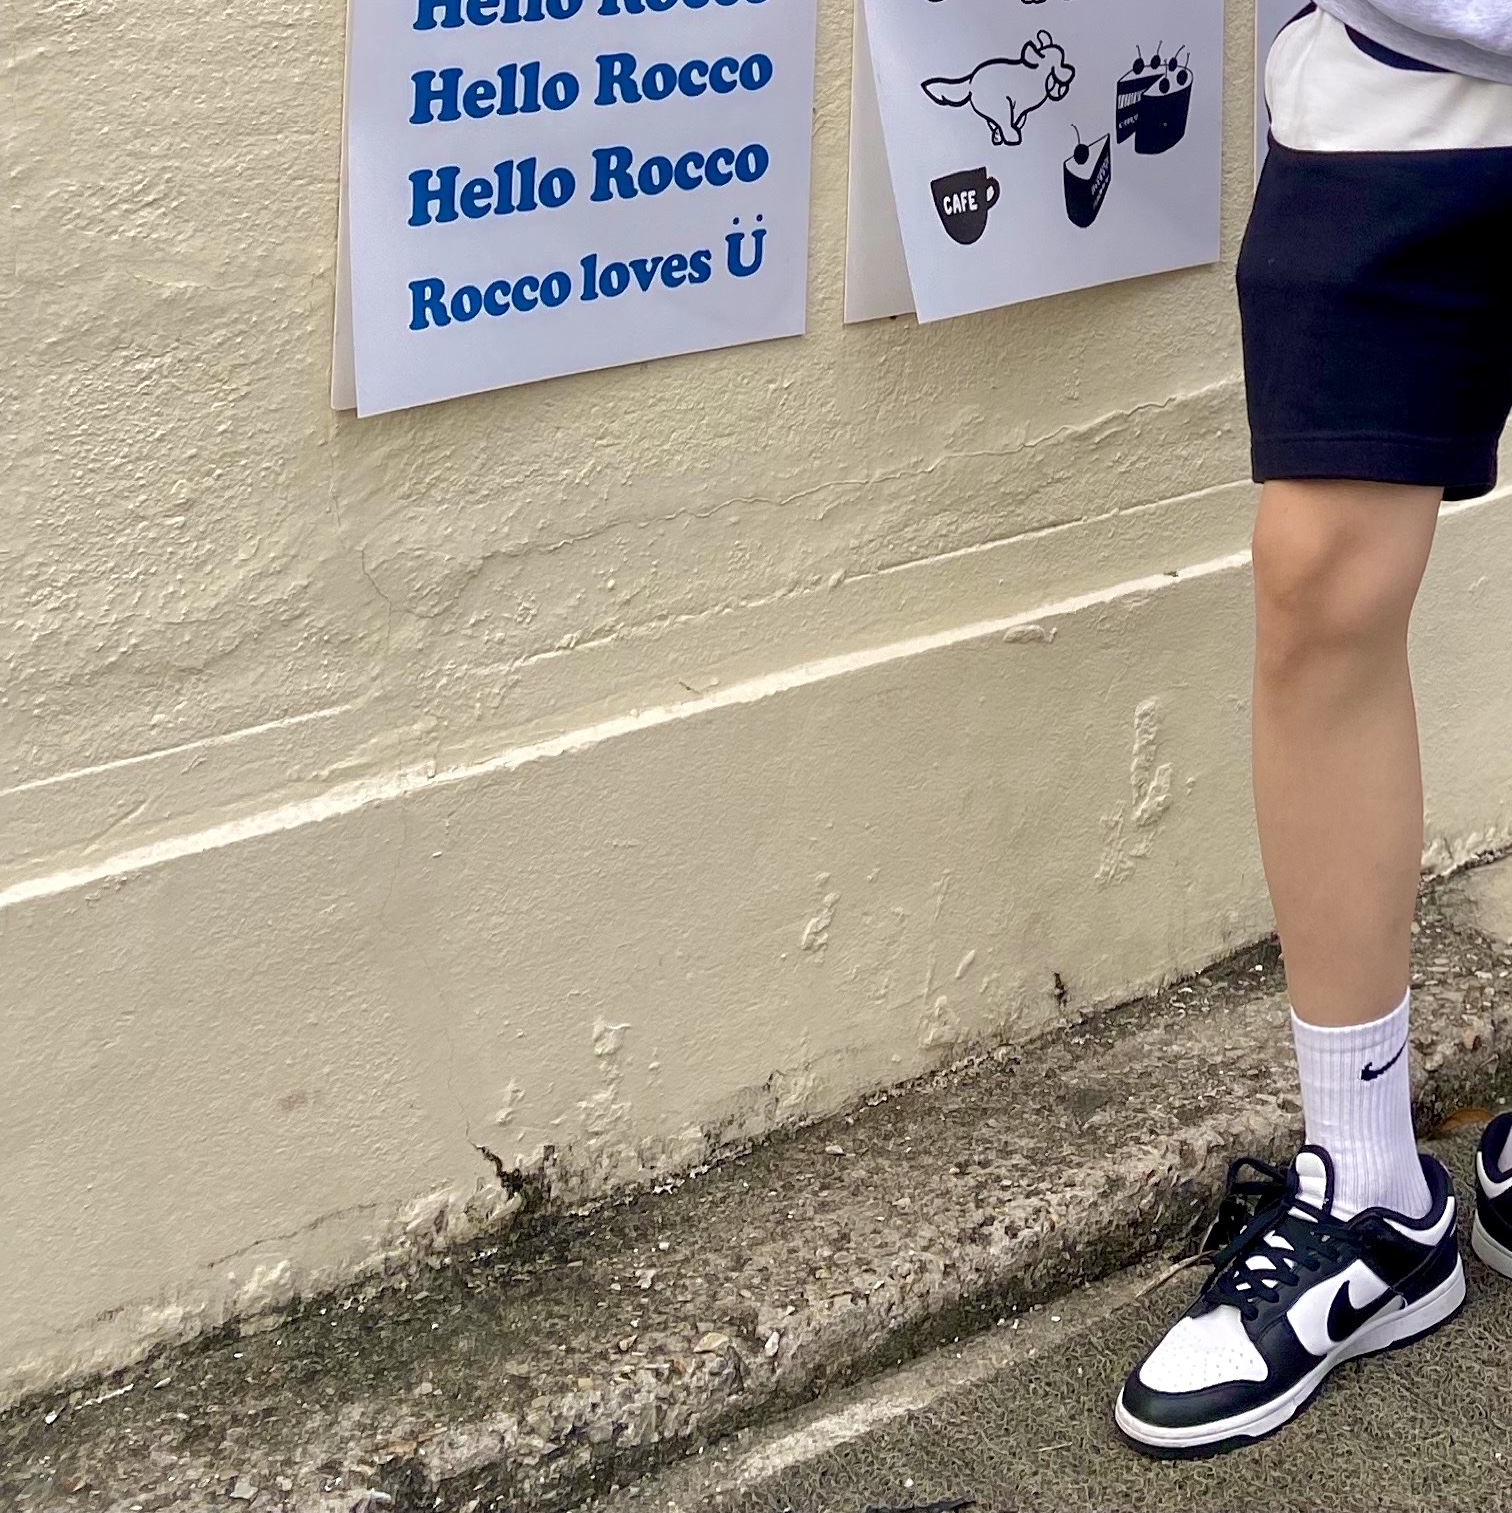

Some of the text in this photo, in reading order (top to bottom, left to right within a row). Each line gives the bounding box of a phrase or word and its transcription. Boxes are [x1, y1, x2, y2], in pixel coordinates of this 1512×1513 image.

[410, 50, 774, 126] Hello Rocco
[408, 143, 770, 228] Hello Rocco
[942, 189, 979, 216] CAFE
[408, 268, 573, 332] Rocco
[580, 244, 712, 303] loves
